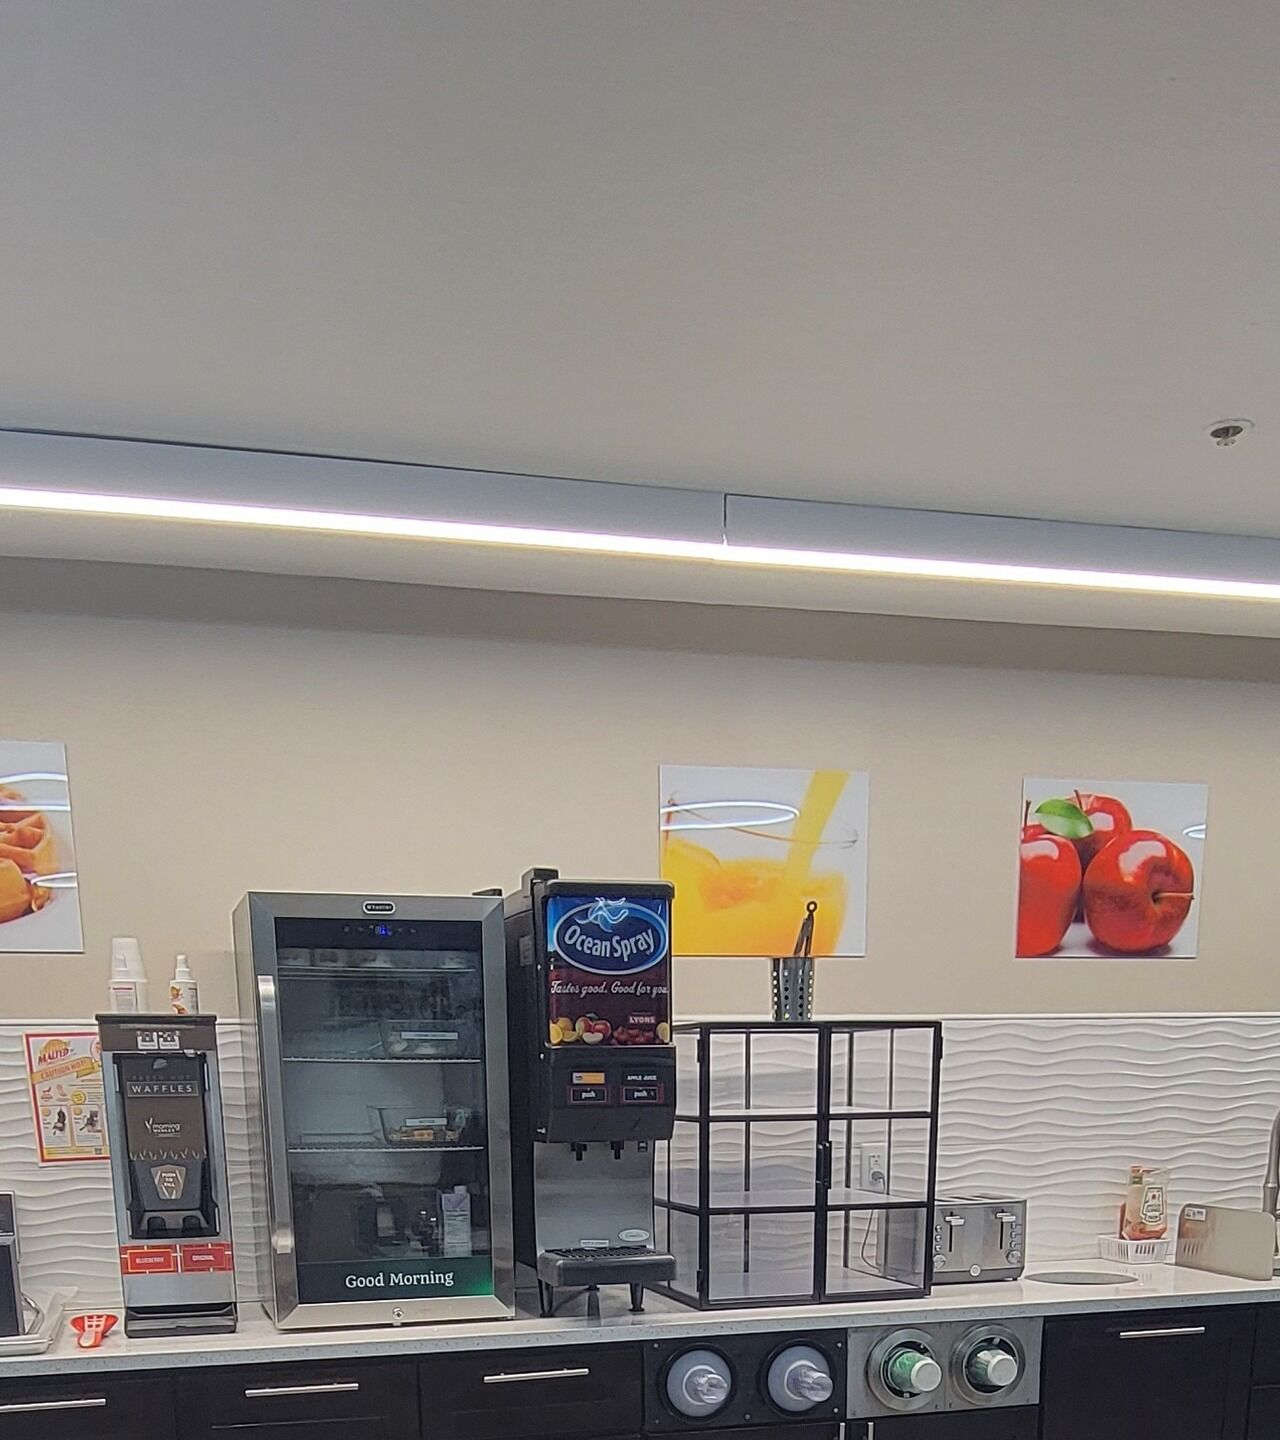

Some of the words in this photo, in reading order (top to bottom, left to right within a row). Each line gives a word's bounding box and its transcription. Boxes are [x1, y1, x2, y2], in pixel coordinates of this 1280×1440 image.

[564, 925, 610, 957] Ocean
[612, 928, 655, 961] Spray
[550, 980, 579, 994] Tastes
[580, 981, 608, 998] good.
[611, 981, 634, 994] Good
[635, 981, 651, 996] for
[629, 1016, 655, 1024] LYONS
[40, 1064, 71, 1080] CAUTION
[131, 1084, 193, 1093] WAFFLES
[581, 1090, 596, 1099] push
[634, 1089, 648, 1098] push
[345, 1272, 385, 1288] Good
[389, 1270, 454, 1287] Morning
